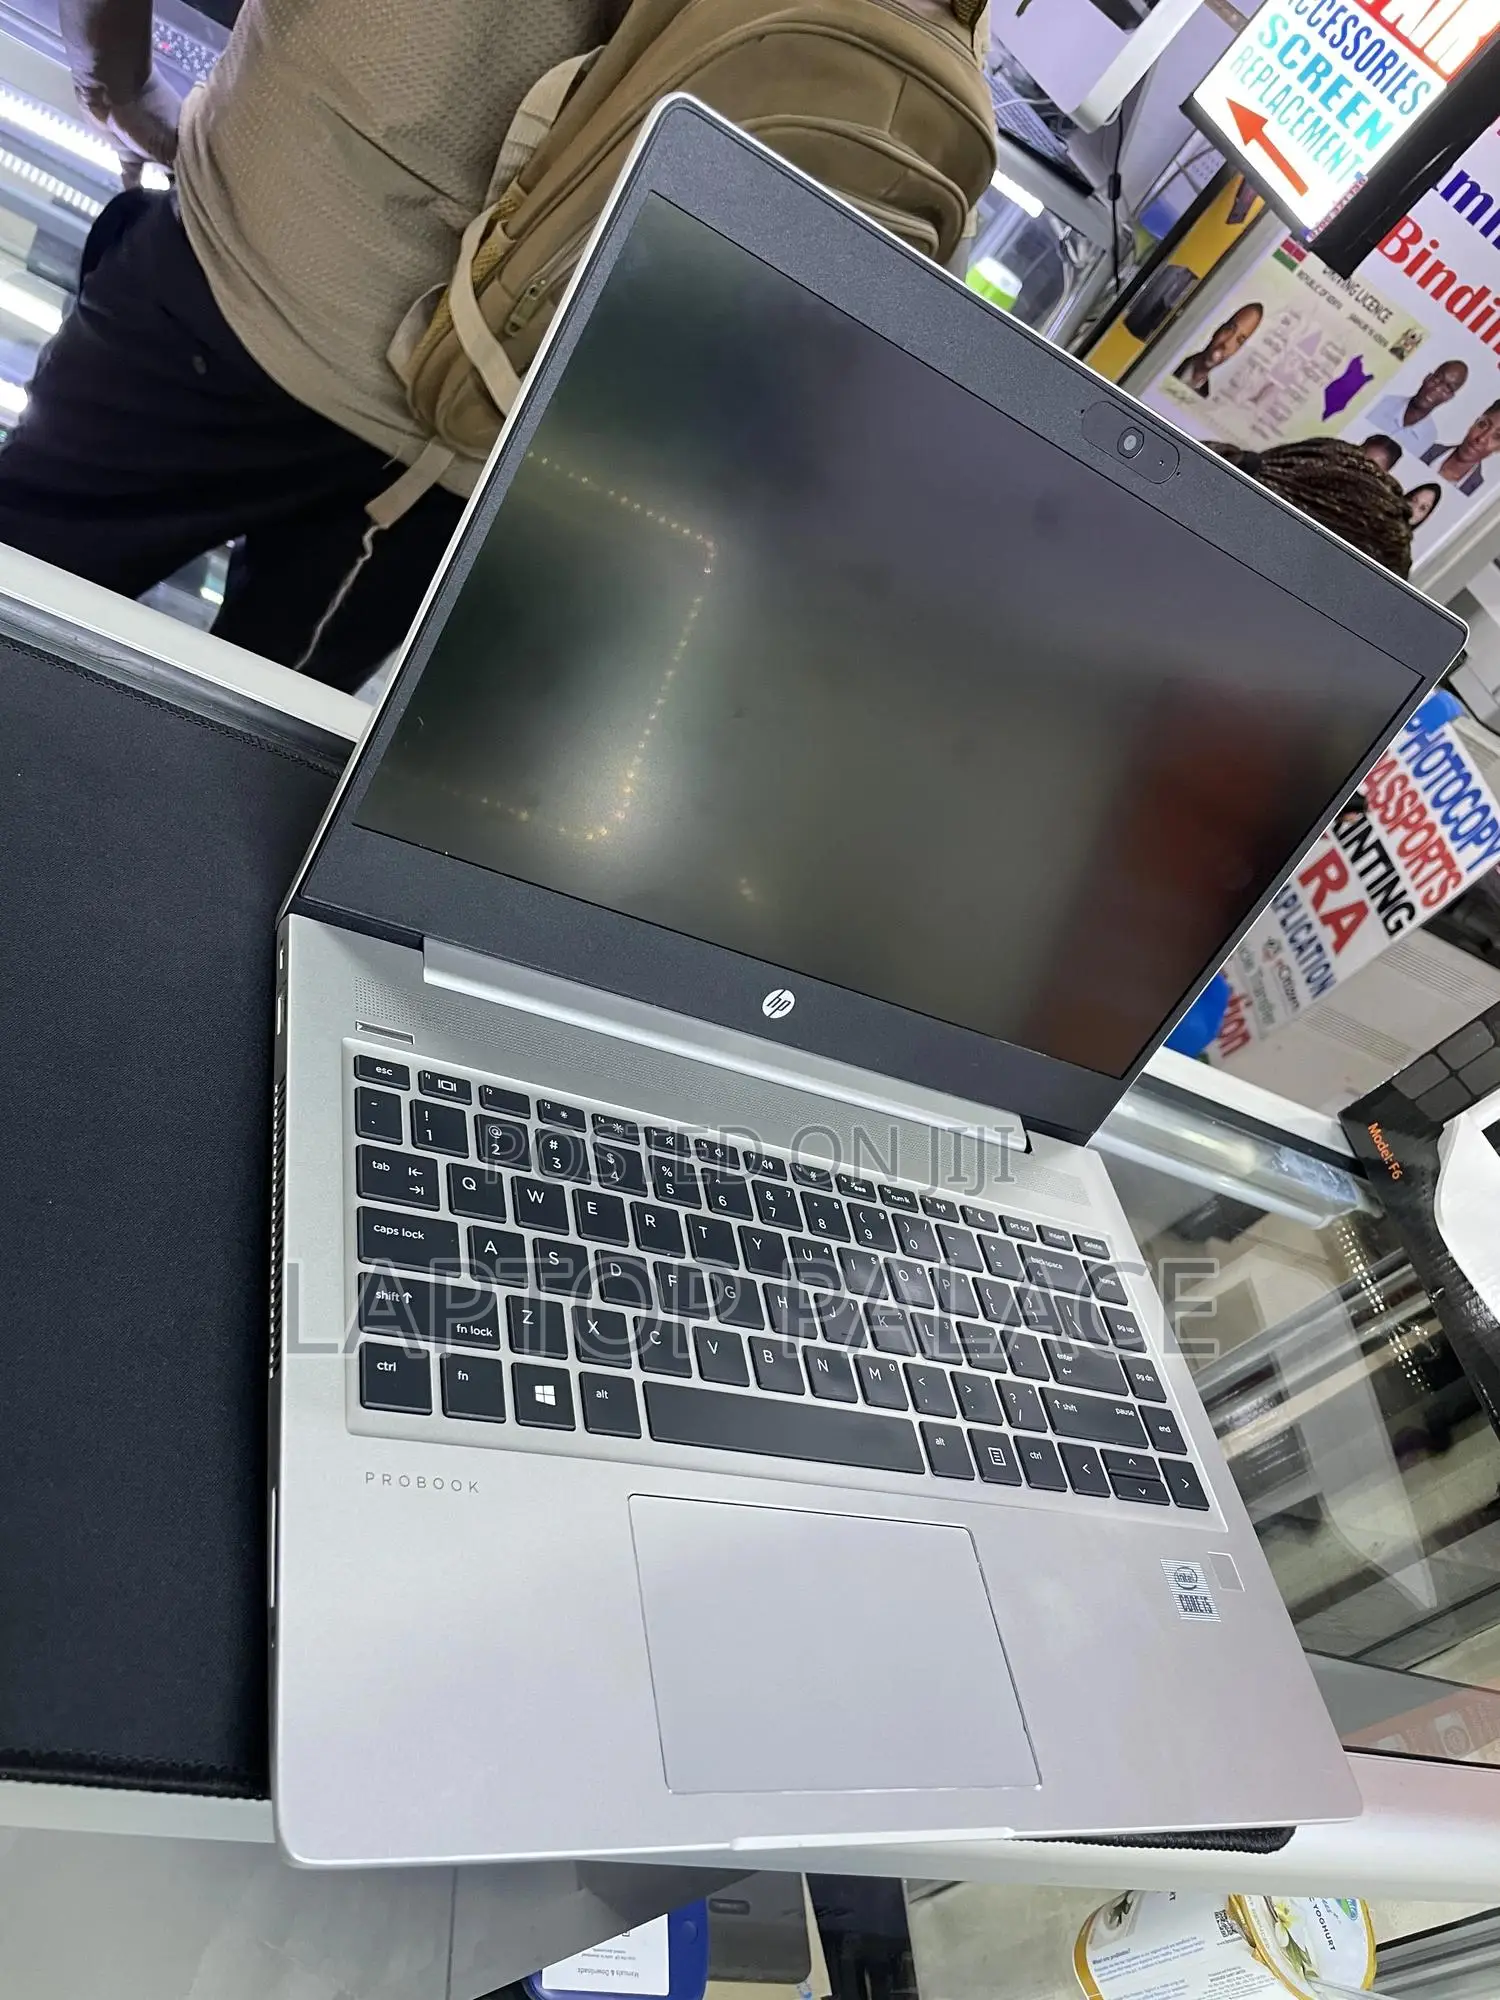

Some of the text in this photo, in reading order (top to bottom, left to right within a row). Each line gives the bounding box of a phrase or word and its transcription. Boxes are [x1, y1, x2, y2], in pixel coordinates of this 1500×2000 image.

[1288, 0, 1431, 115] CESSORIES
[1258, 13, 1394, 151] SCREEN
[1229, 45, 1366, 185] REPLACEMENT
[1353, 288, 1394, 324] LICENCE
[1361, 752, 1463, 909] ASSPORTS
[1331, 810, 1416, 936] INTING
[1298, 848, 1370, 958] RA
[375, 1066, 393, 1076] esc
[426, 1129, 432, 1141] 1
[491, 1144, 500, 1156] 2
[1367, 1122, 1403, 1180] Model: F6
[372, 1160, 391, 1172] tab
[552, 1157, 562, 1169] 3
[611, 1171, 620, 1182] 4
[462, 1177, 477, 1191] Q
[665, 1183, 675, 1195] 5
[527, 1189, 545, 1204] W
[718, 1195, 728, 1207] 6
[587, 1201, 598, 1215] E
[769, 1207, 776, 1218] 7
[645, 1214, 656, 1228] R
[818, 1218, 827, 1230] 8
[373, 1224, 425, 1240] caps lock
[699, 1226, 708, 1239] T
[865, 1229, 873, 1240] 9
[484, 1241, 498, 1255] A
[752, 1237, 762, 1250] Y
[549, 1251, 560, 1266] S
[802, 1248, 813, 1261] U
[609, 1263, 622, 1277] D
[667, 1274, 678, 1287] F
[942, 1279, 951, 1289] P
[375, 1290, 400, 1303] shift
[724, 1285, 737, 1299] G
[777, 1295, 789, 1309] H
[522, 1309, 534, 1325] Z
[829, 1307, 836, 1318] J
[587, 1319, 600, 1335] X
[878, 1315, 889, 1328] K
[456, 1324, 493, 1337] fn lock
[925, 1324, 934, 1337] L
[650, 1330, 662, 1345] C
[707, 1340, 718, 1355] V
[763, 1349, 774, 1364] B
[1056, 1353, 1073, 1362] enter
[376, 1361, 397, 1372] ctrl
[817, 1358, 829, 1372] N
[457, 1370, 469, 1381] fn
[868, 1367, 882, 1381] M
[596, 1389, 609, 1399] alt
[1062, 1403, 1078, 1413] shift
[1115, 1407, 1135, 1417] pause
[1158, 1425, 1172, 1433] end
[935, 1437, 946, 1447] alt
[1029, 1451, 1042, 1460] ctrl
[365, 1472, 479, 1493] PROBOOK
[1312, 1904, 1336, 1952] YOGHURT
